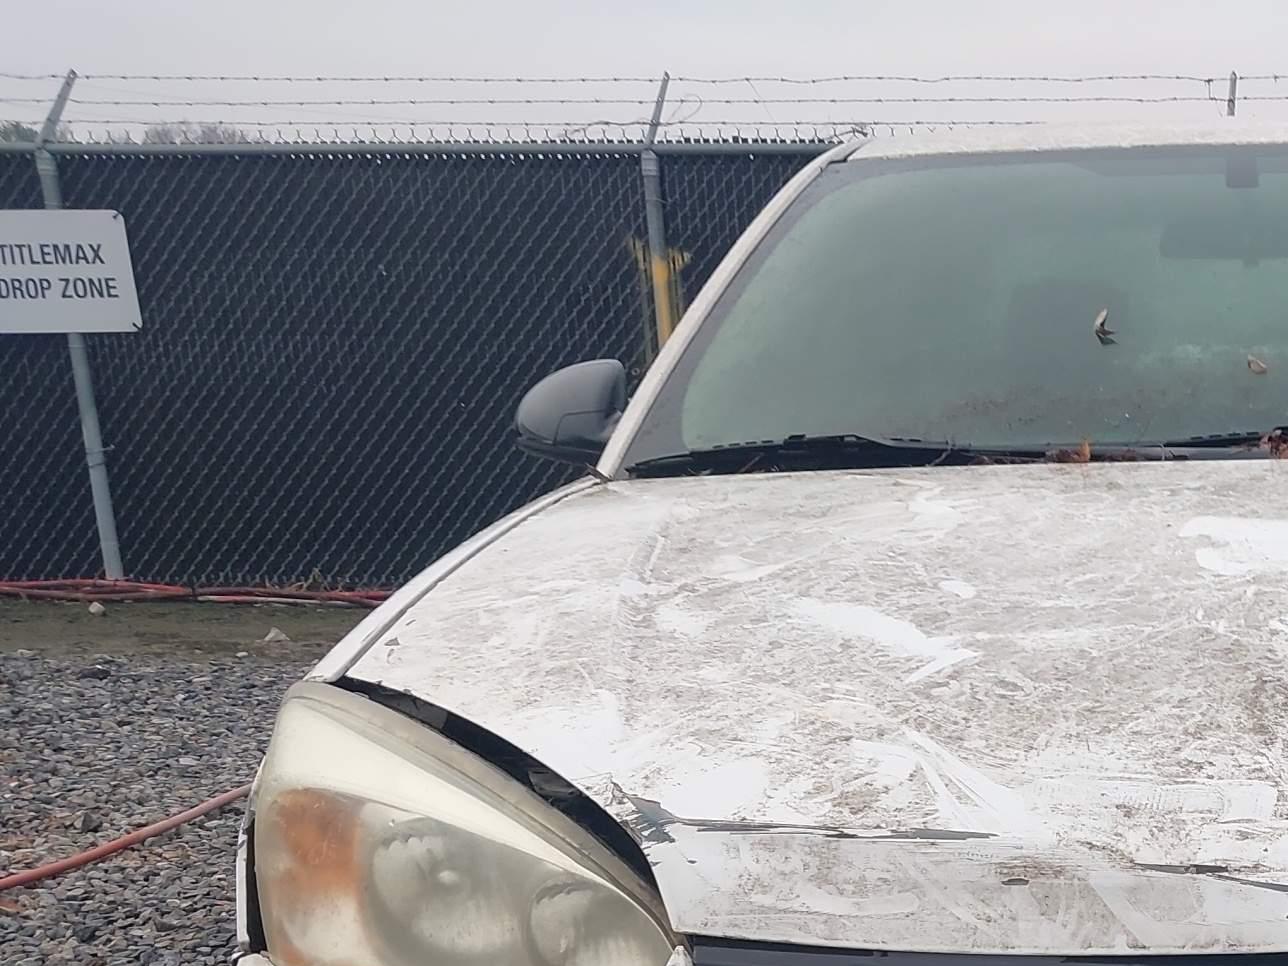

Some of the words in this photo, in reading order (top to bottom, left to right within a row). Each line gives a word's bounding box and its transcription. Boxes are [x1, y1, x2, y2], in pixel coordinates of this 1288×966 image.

[0, 243, 106, 265] TITLEMAX
[0, 277, 52, 299] DROP
[58, 277, 120, 299] ZONE
